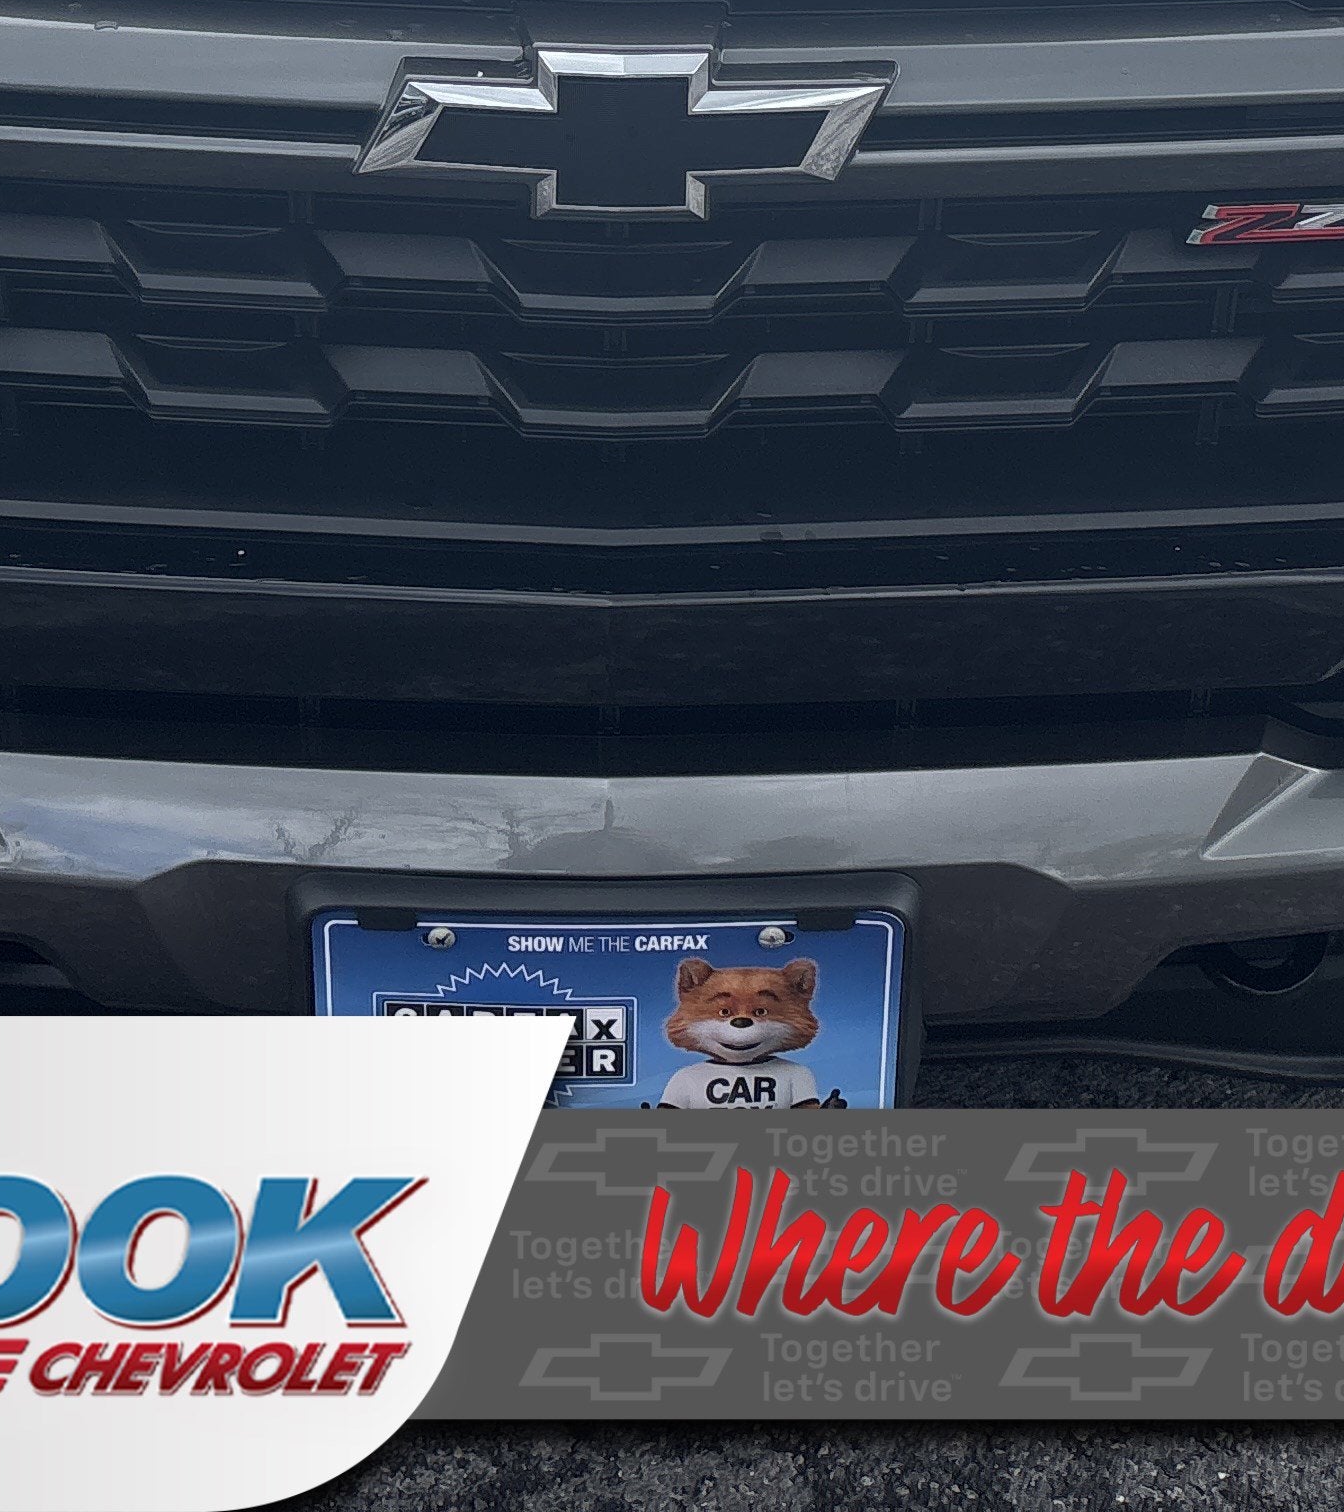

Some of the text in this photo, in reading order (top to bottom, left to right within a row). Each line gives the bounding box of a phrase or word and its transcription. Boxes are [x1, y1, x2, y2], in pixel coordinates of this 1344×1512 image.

[508, 934, 709, 952] SHOW ME THE CARFAX
[705, 1076, 777, 1104] CAR
